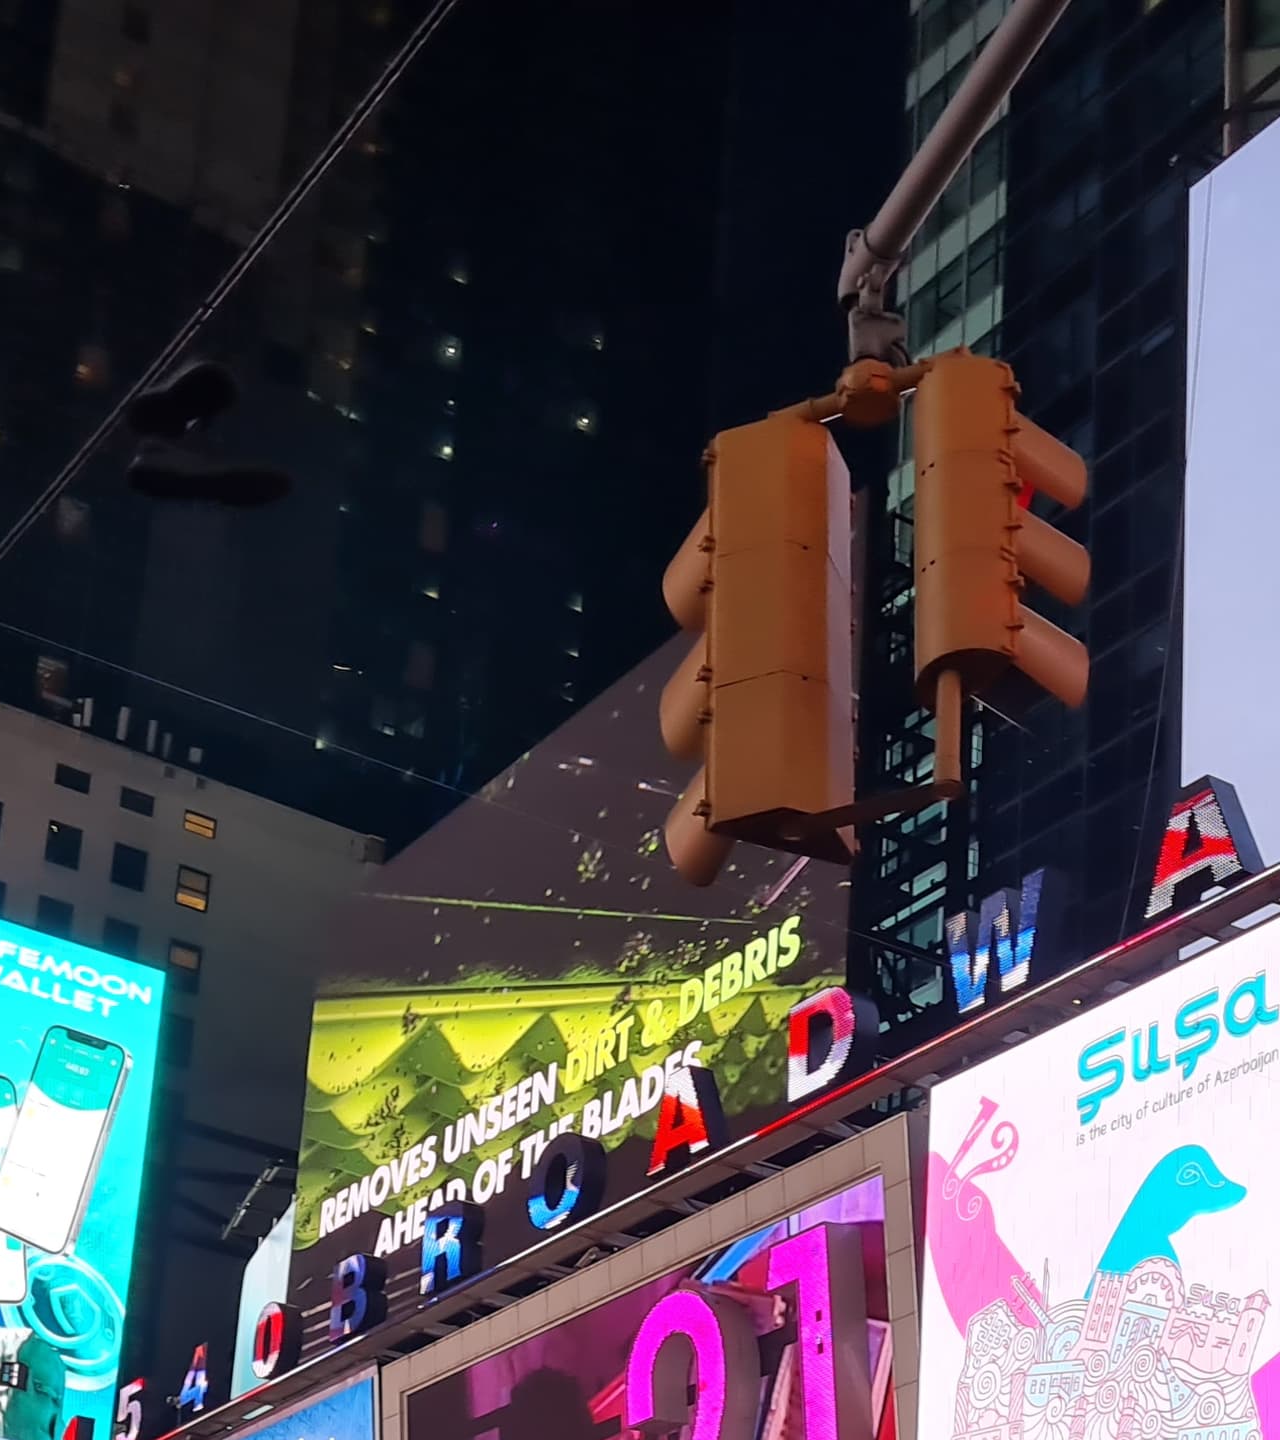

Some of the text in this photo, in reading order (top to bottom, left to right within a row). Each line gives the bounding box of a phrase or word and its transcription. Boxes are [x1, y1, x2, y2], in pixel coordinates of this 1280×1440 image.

[319, 915, 802, 1239] REMOVES UNSEEN DIRT & DEBRIS
[1075, 1048, 1280, 1147] is the city of culture of Azerbaijan
[472, 1157, 512, 1206] OF
